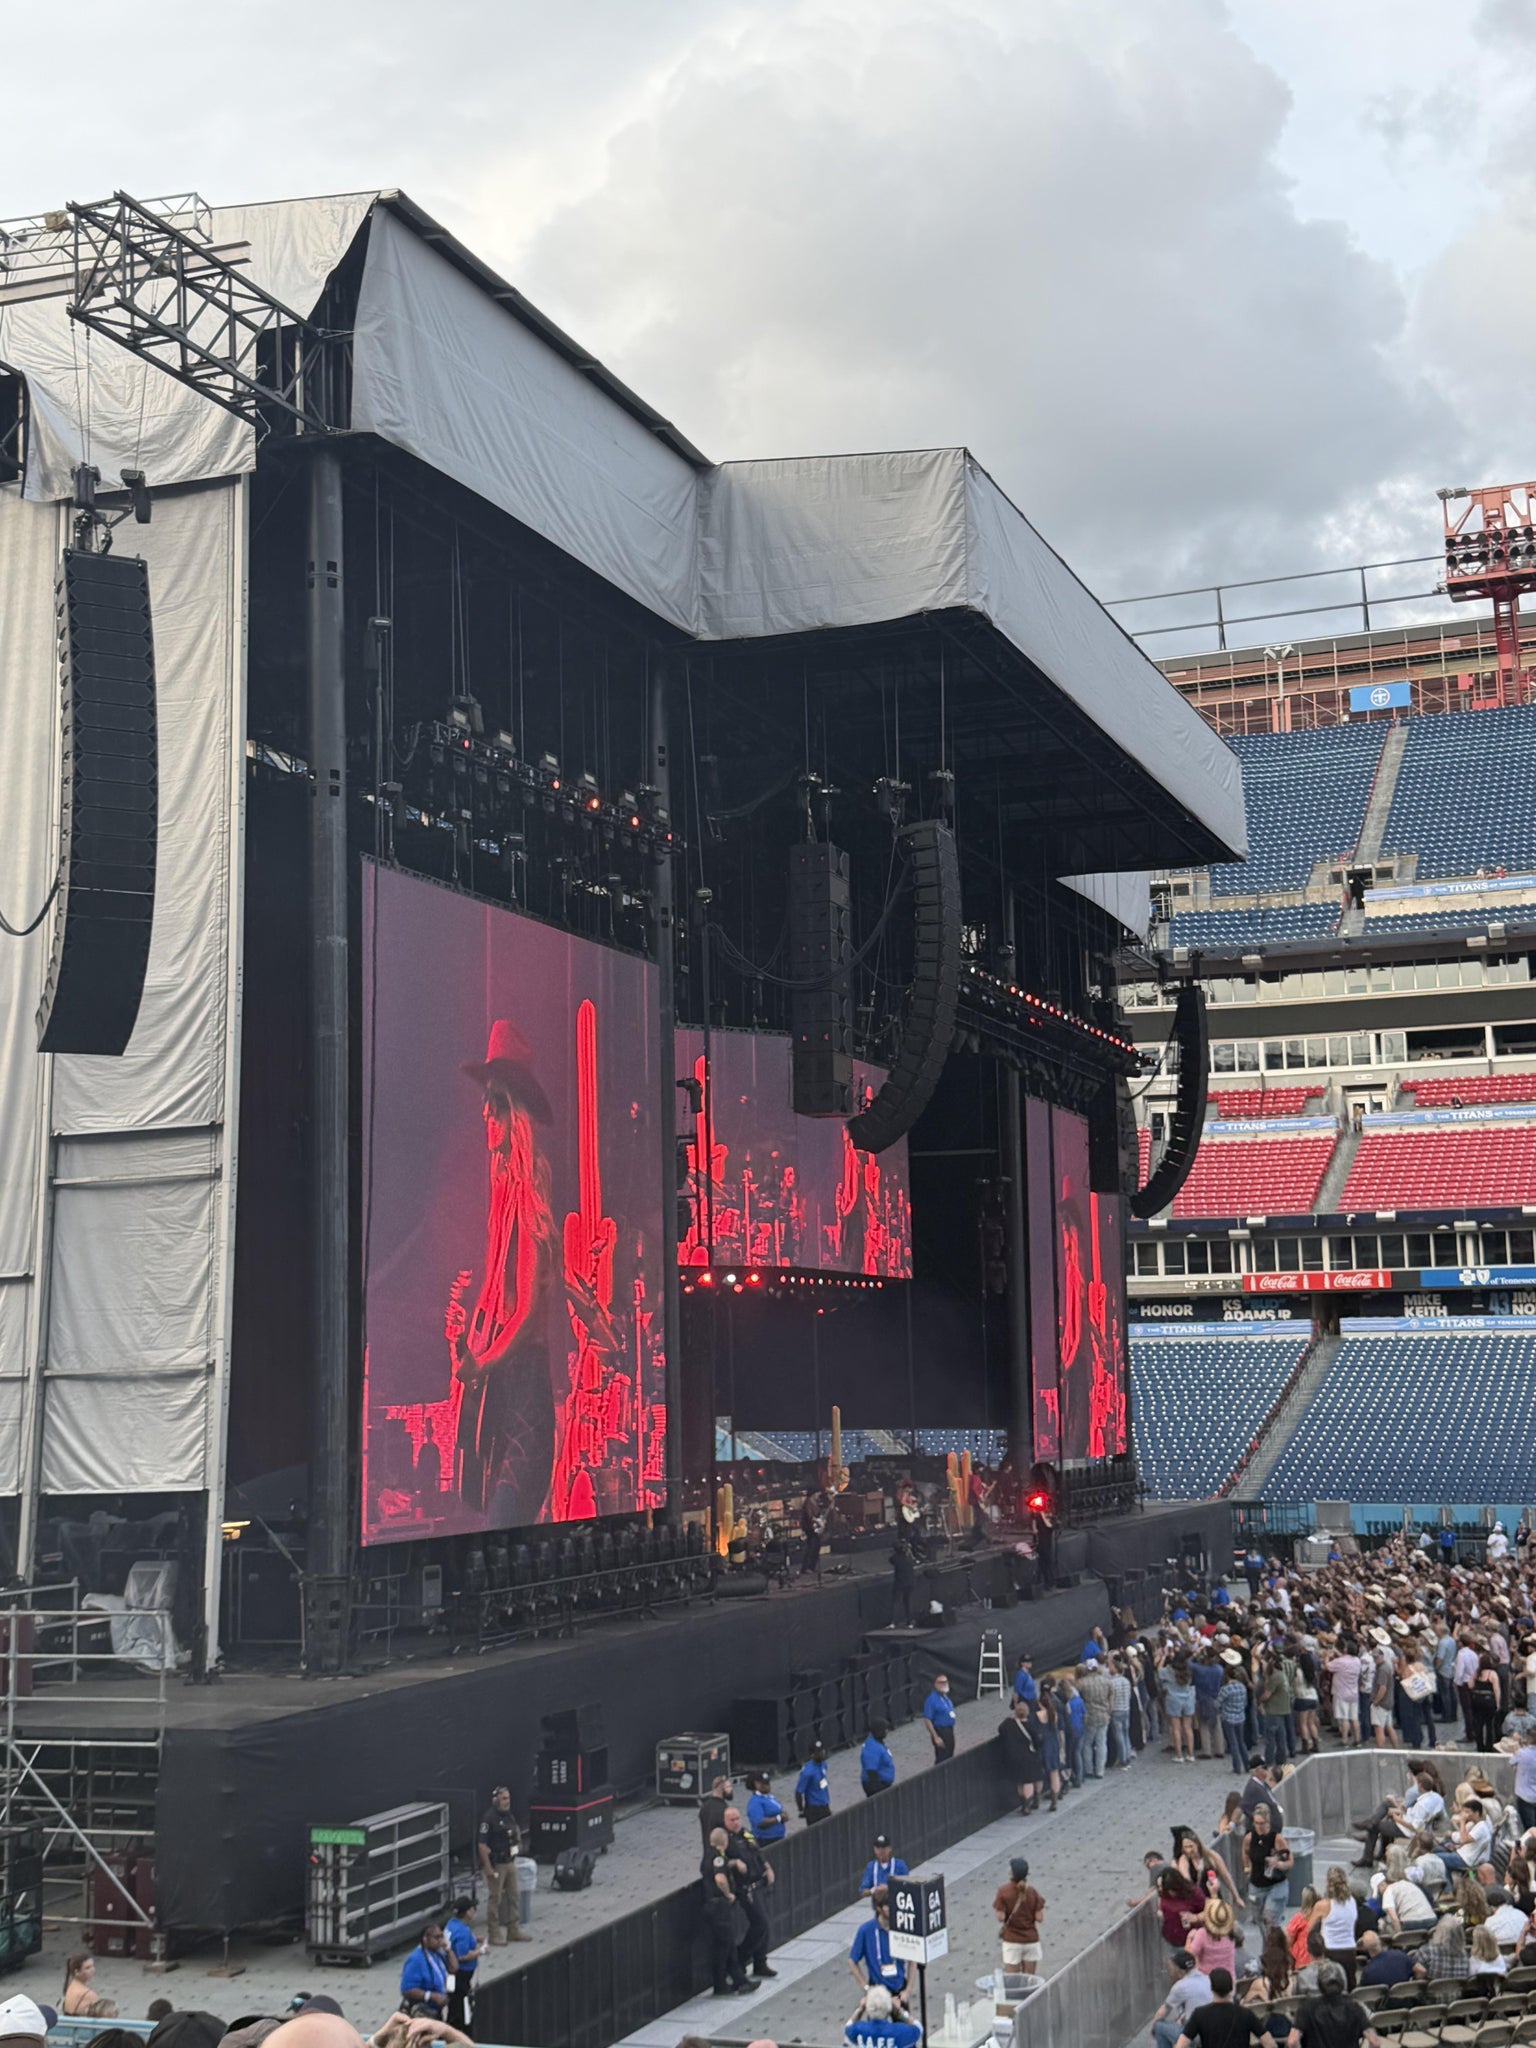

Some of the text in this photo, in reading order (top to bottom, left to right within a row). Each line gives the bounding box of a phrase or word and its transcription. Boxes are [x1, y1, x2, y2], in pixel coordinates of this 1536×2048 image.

[1448, 881, 1489, 893] TITANS
[1450, 1110, 1493, 1120] TITANS
[1226, 1121, 1267, 1131] TITANS
[1222, 1299, 1242, 1311] KS
[1404, 1294, 1442, 1306] MIKE
[1489, 1291, 1511, 1315] 43
[1140, 1304, 1194, 1317] HONOR
[1223, 1309, 1276, 1322] ADAMS
[1404, 1305, 1448, 1318] KEITH
[1160, 1325, 1205, 1334] TITANS
[1438, 1318, 1485, 1328] TITANS
[896, 1891, 915, 1912] GA
[928, 1890, 941, 1910] GA
[896, 1910, 916, 1932] PIT
[928, 1908, 942, 1931] PIT
